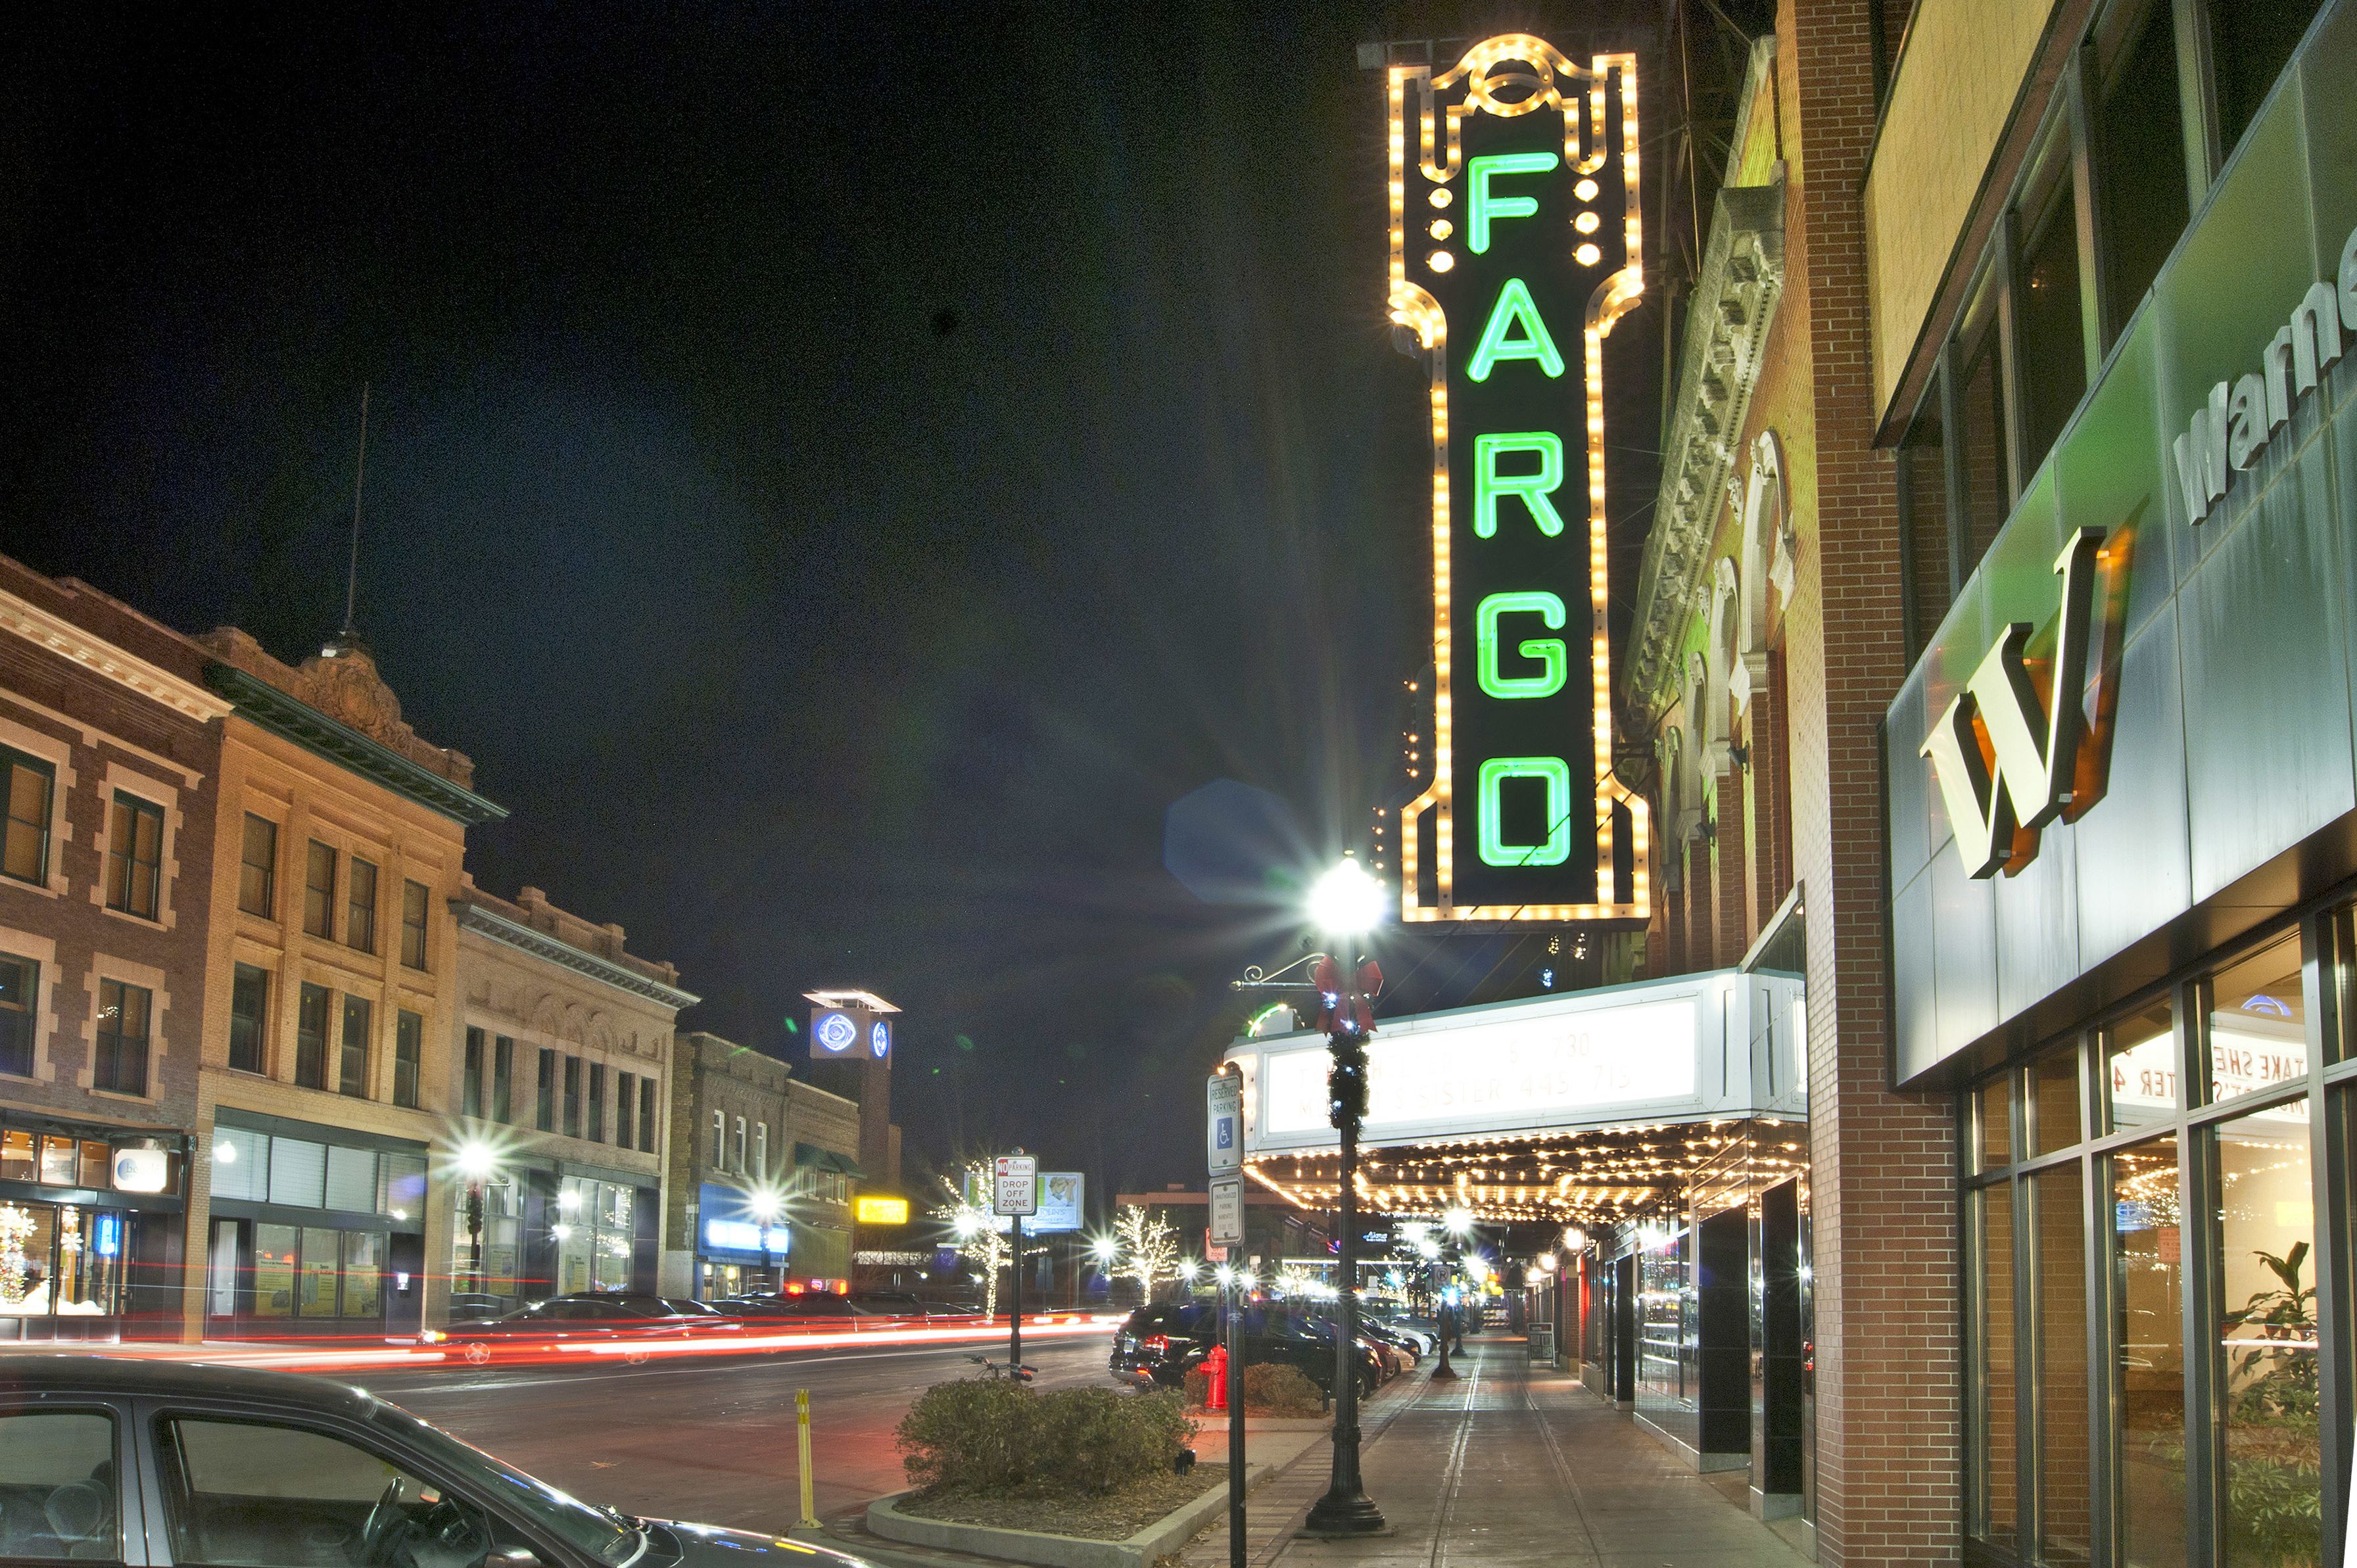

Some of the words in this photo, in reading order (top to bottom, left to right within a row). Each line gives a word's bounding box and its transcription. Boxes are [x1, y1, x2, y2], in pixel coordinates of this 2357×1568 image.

[1465, 152, 1571, 867] FARGO
[1920, 526, 2104, 879] W
[1552, 1031, 1590, 1059] 730
[1212, 1085, 1237, 1100] RESERVED
[1414, 1076, 1503, 1110] SISTER
[1519, 1069, 1570, 1098] 445
[1592, 1061, 1632, 1093] 715
[1213, 1101, 1236, 1115] PARKING
[998, 1162, 1008, 1174] NO
